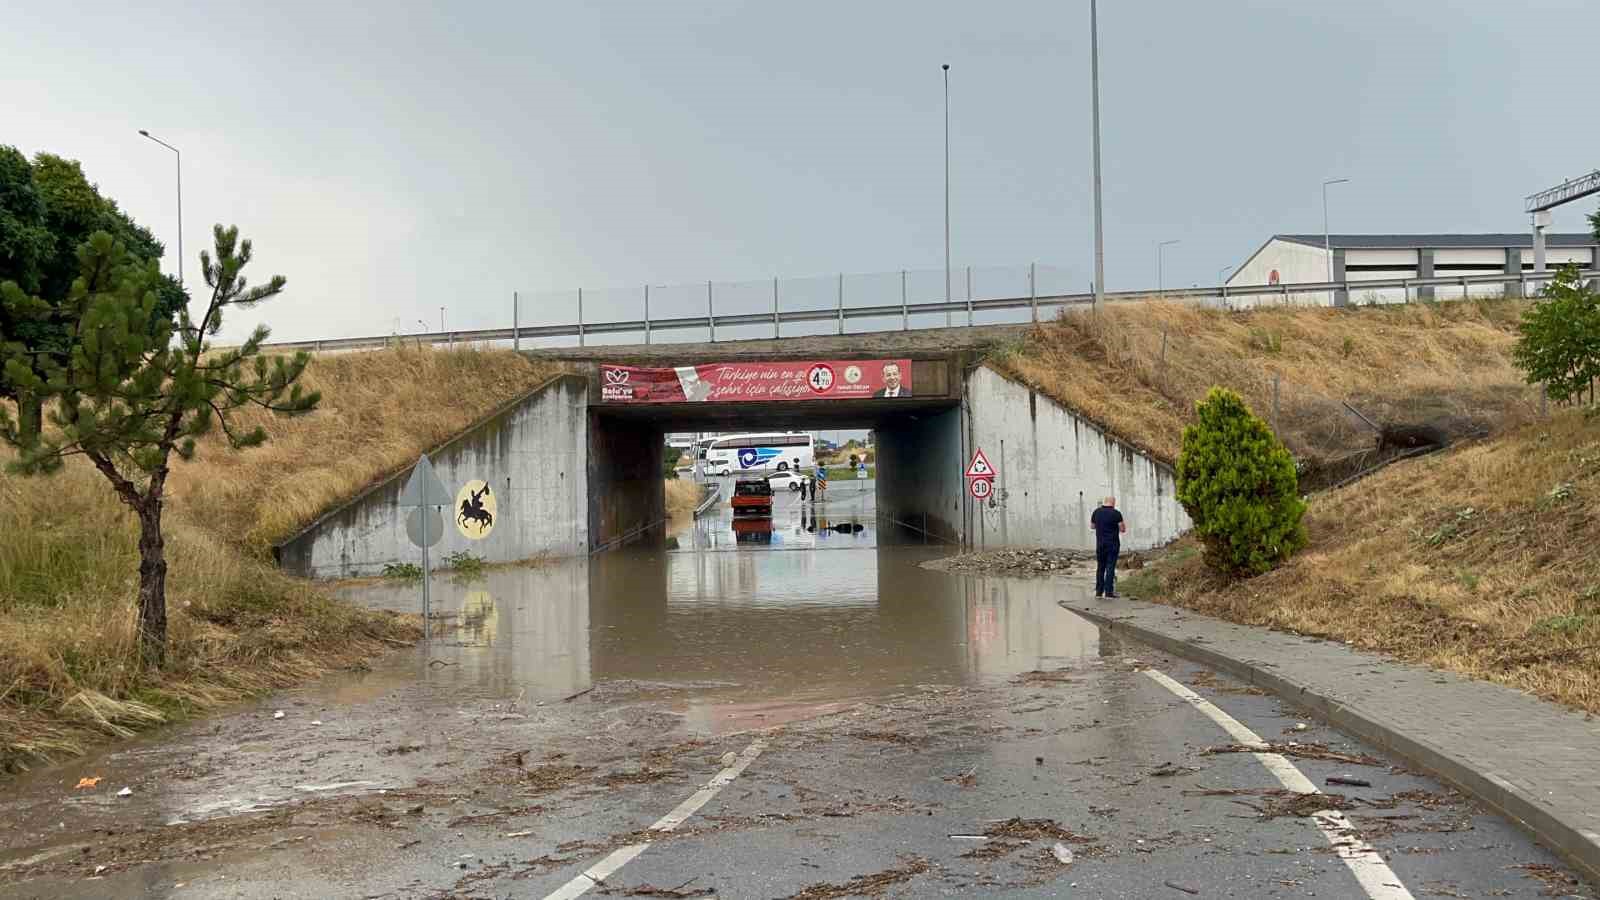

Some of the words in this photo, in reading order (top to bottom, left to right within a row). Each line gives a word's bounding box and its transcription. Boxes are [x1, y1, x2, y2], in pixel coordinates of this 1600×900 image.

[794, 370, 808, 384] g
[812, 372, 820, 386] 4
[974, 482, 987, 493] 30
